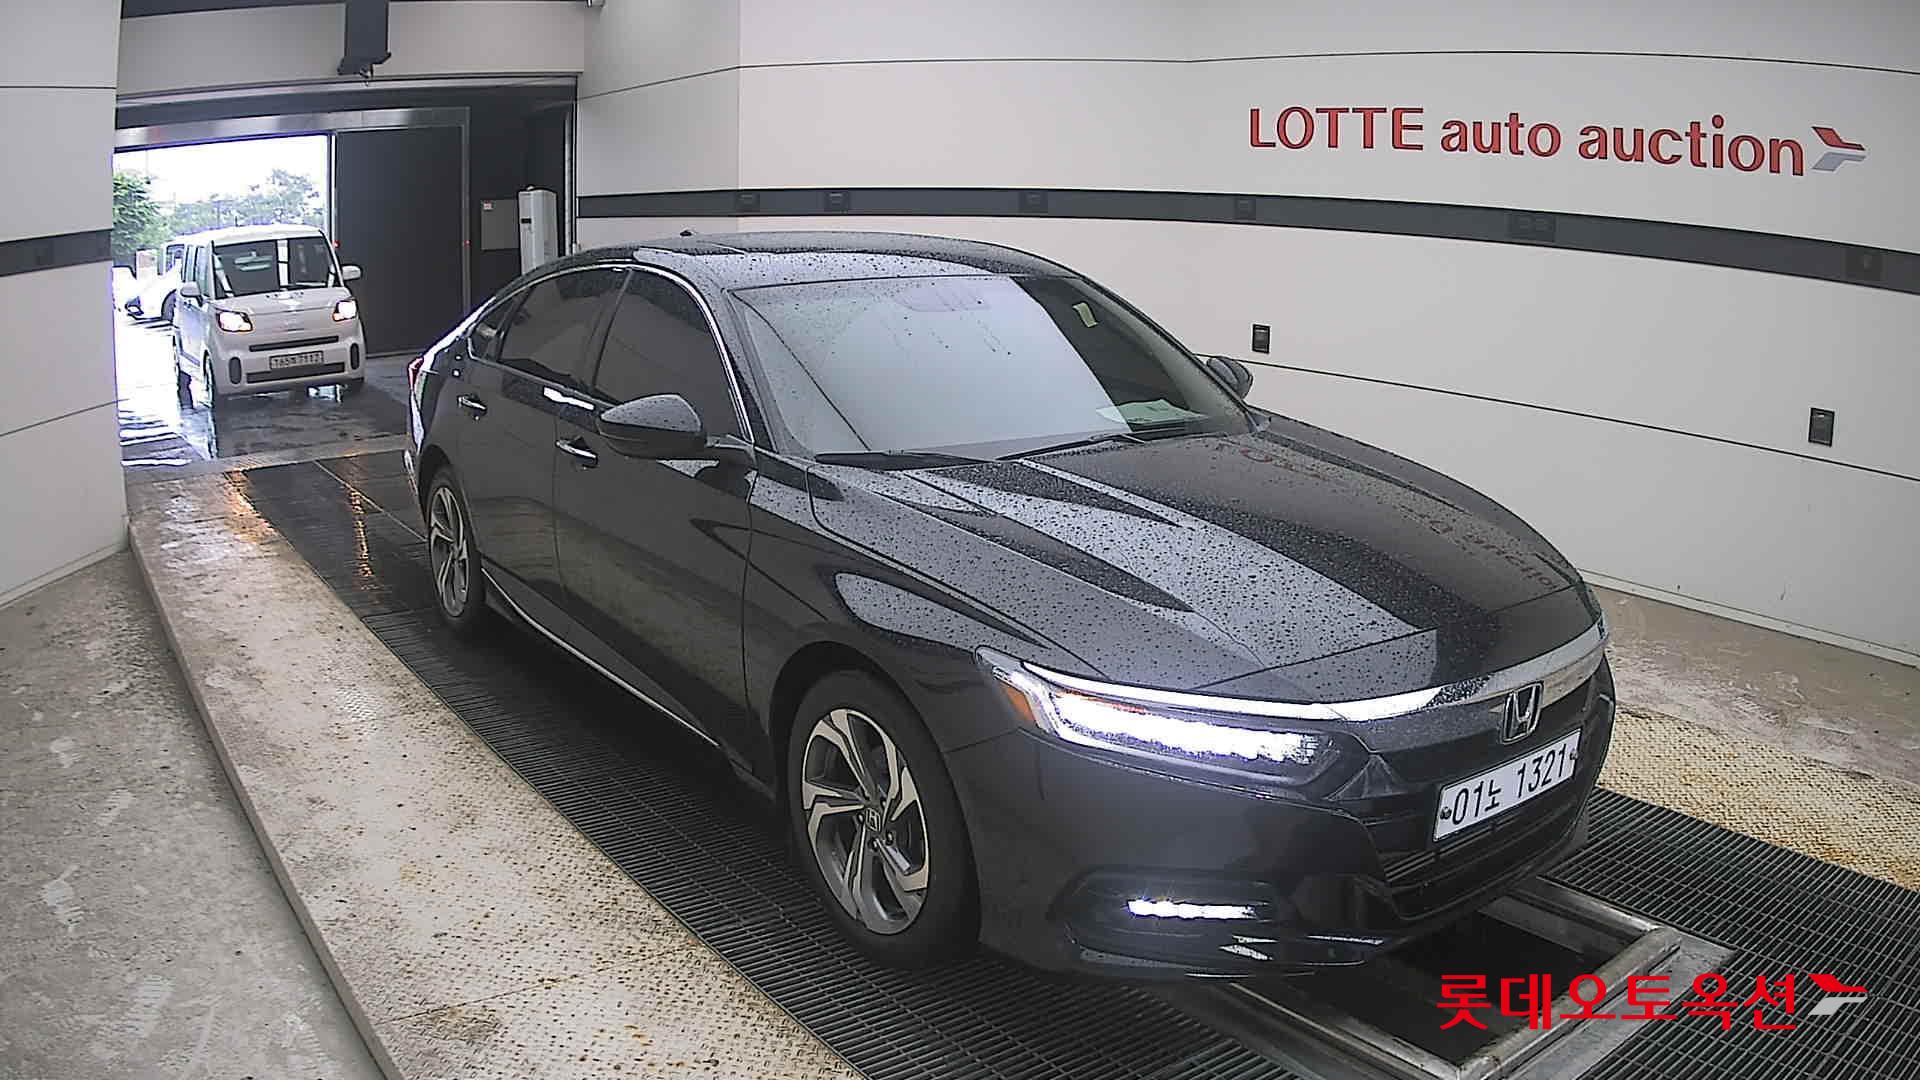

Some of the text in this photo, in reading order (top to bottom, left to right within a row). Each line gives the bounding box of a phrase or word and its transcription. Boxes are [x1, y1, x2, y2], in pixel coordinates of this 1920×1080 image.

[1248, 106, 1806, 177] LOTTE auto auction
[1451, 743, 1567, 825] 01노 1321
